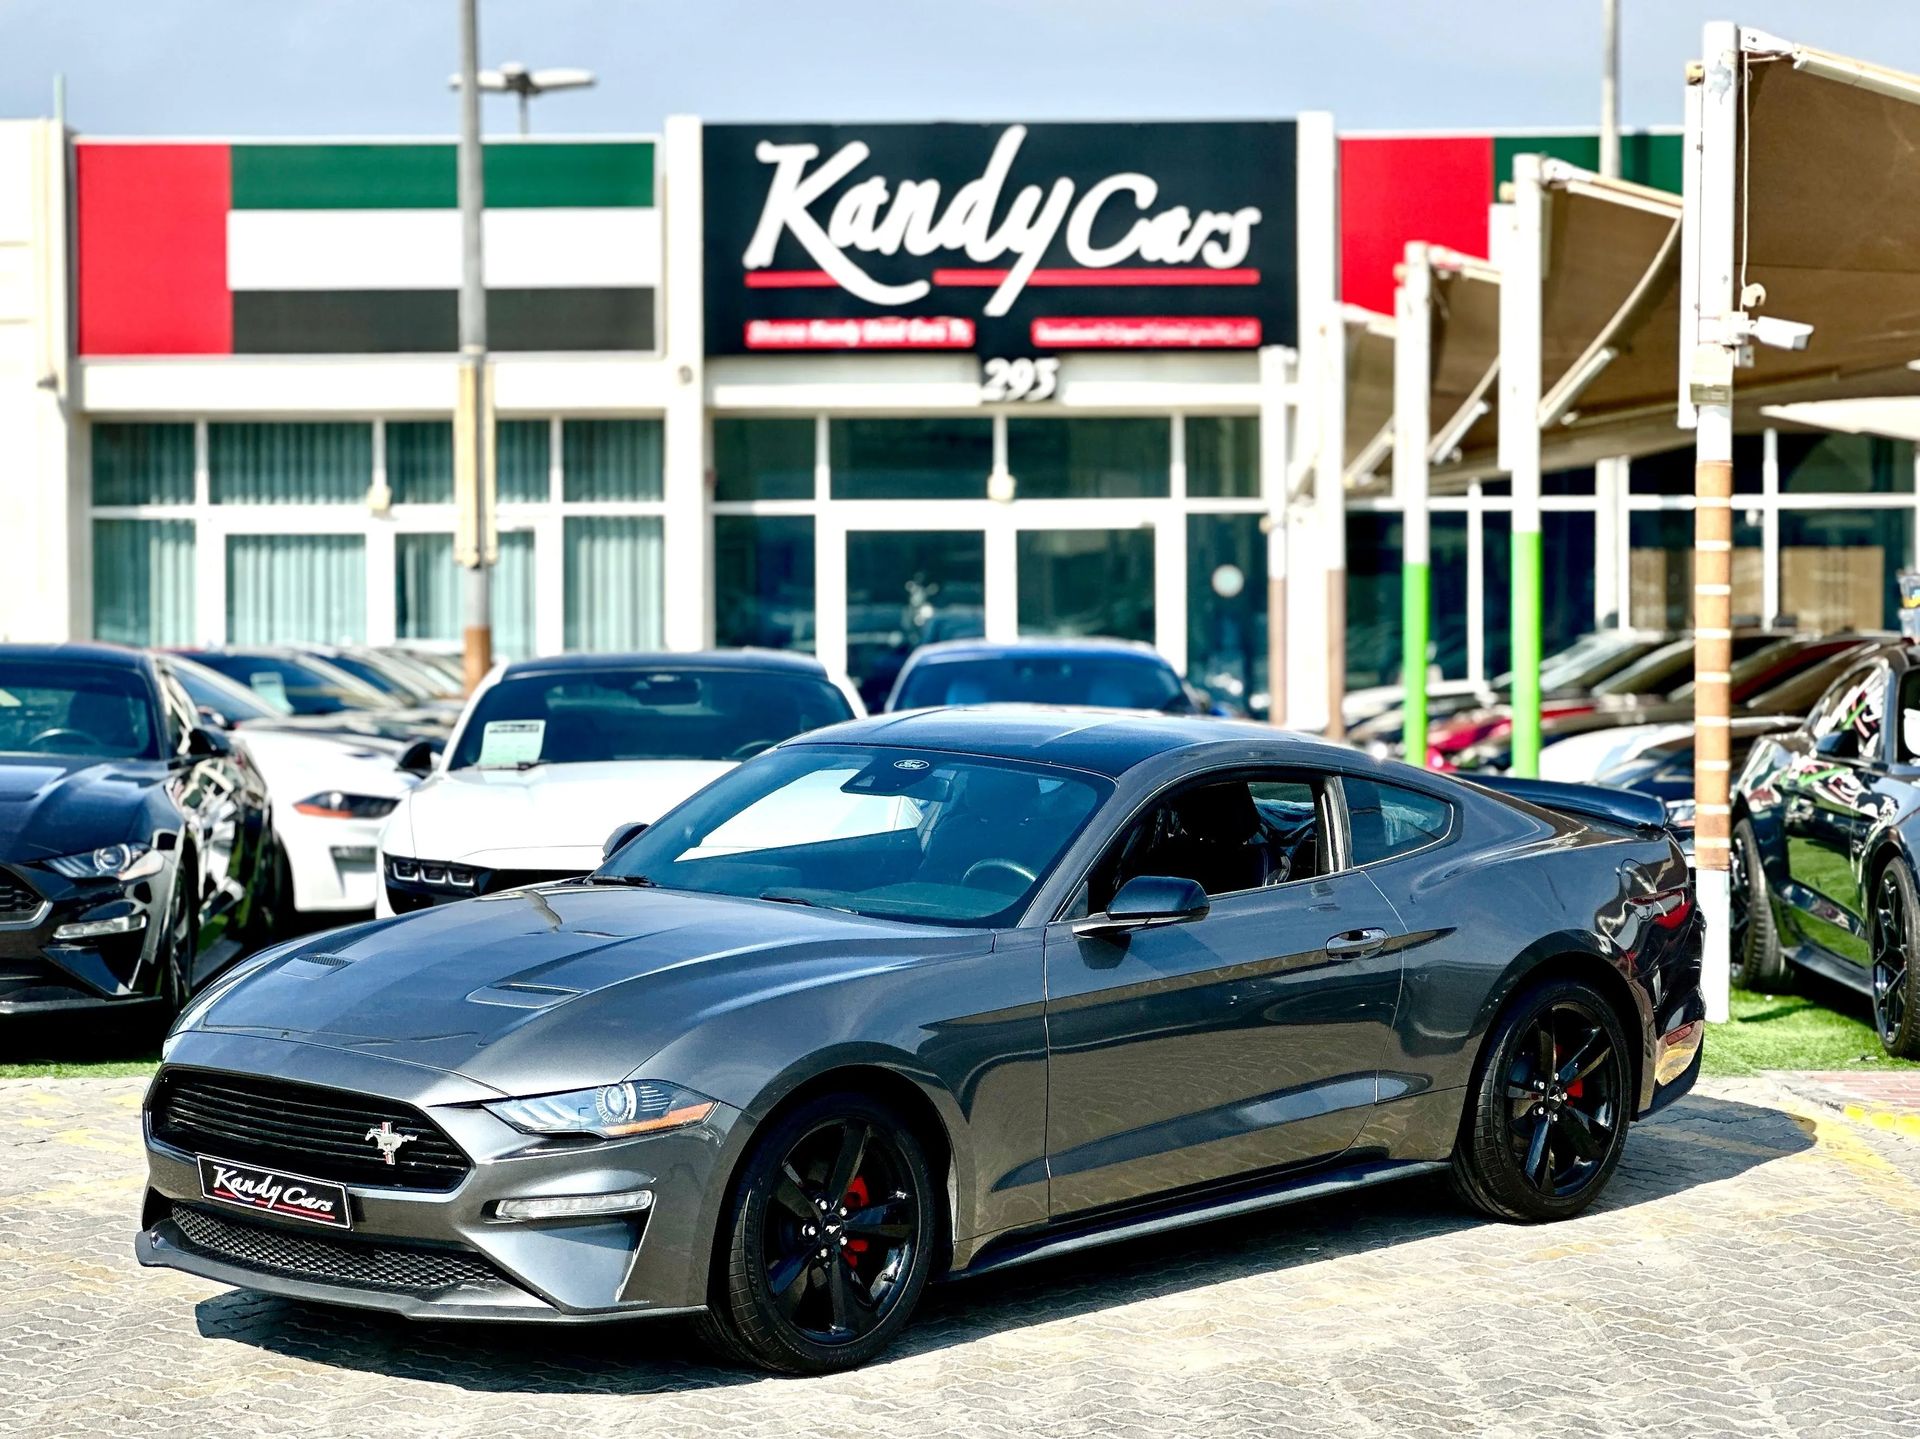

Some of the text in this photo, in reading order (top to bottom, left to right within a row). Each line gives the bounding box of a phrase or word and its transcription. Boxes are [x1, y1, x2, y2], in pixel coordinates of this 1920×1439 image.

[742, 124, 1262, 317] Kandy Cars
[980, 357, 1060, 402] 295
[212, 1165, 334, 1212] Kandy Cars
